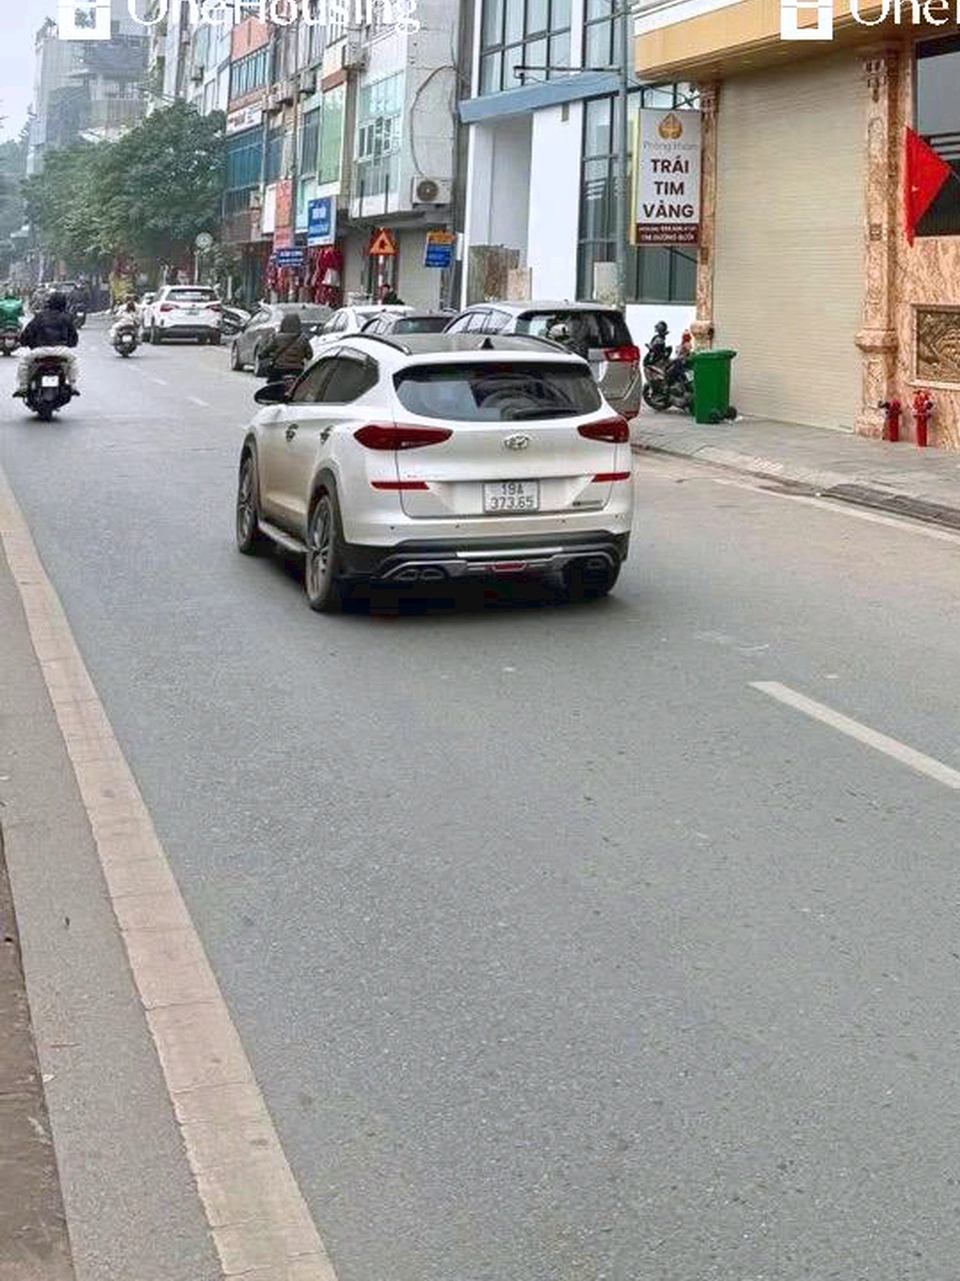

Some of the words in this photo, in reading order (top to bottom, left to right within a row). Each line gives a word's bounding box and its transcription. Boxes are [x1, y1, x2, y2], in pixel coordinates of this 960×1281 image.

[650, 155, 690, 174] TRÁI
[654, 181, 685, 196] TIM
[643, 200, 695, 219] VÀNG
